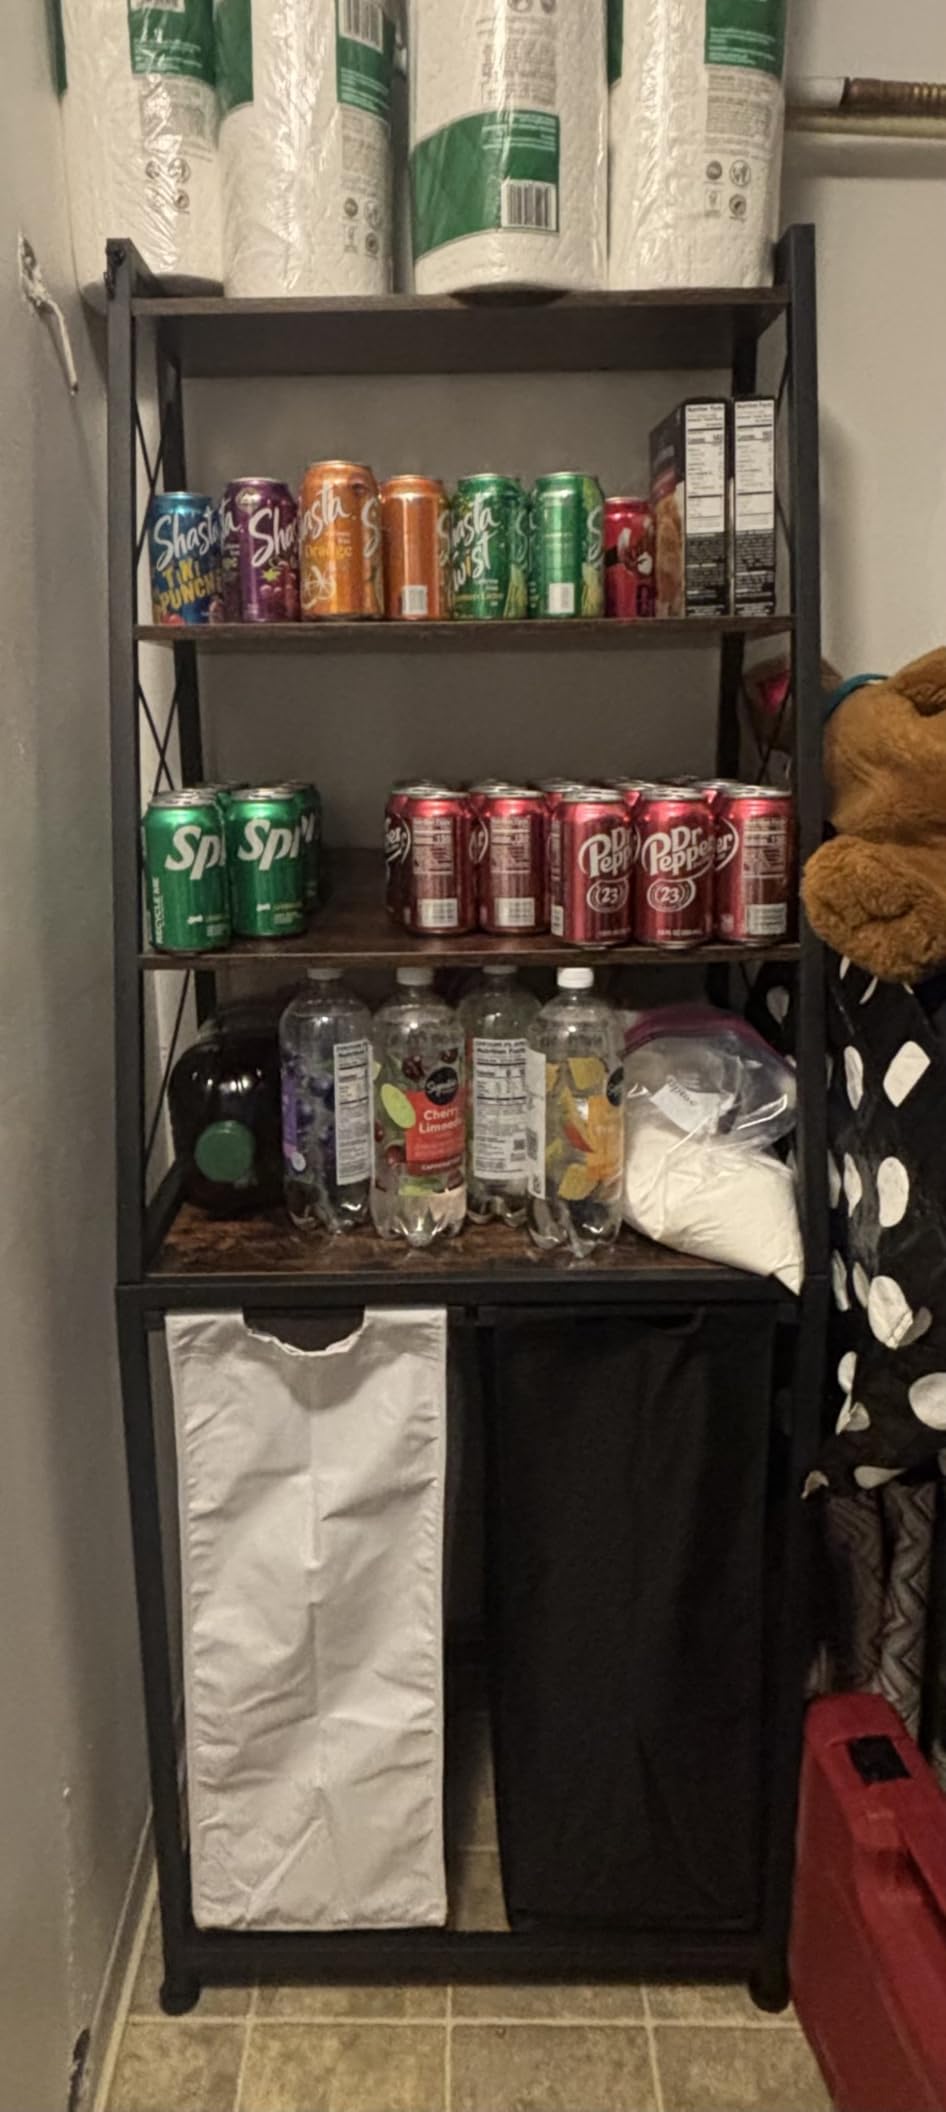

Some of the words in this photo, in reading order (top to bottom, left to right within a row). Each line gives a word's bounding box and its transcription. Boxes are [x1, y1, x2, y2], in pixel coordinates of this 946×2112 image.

[670, 826, 703, 852] Dr
[601, 886, 618, 904] 23
[660, 886, 680, 903] 23
